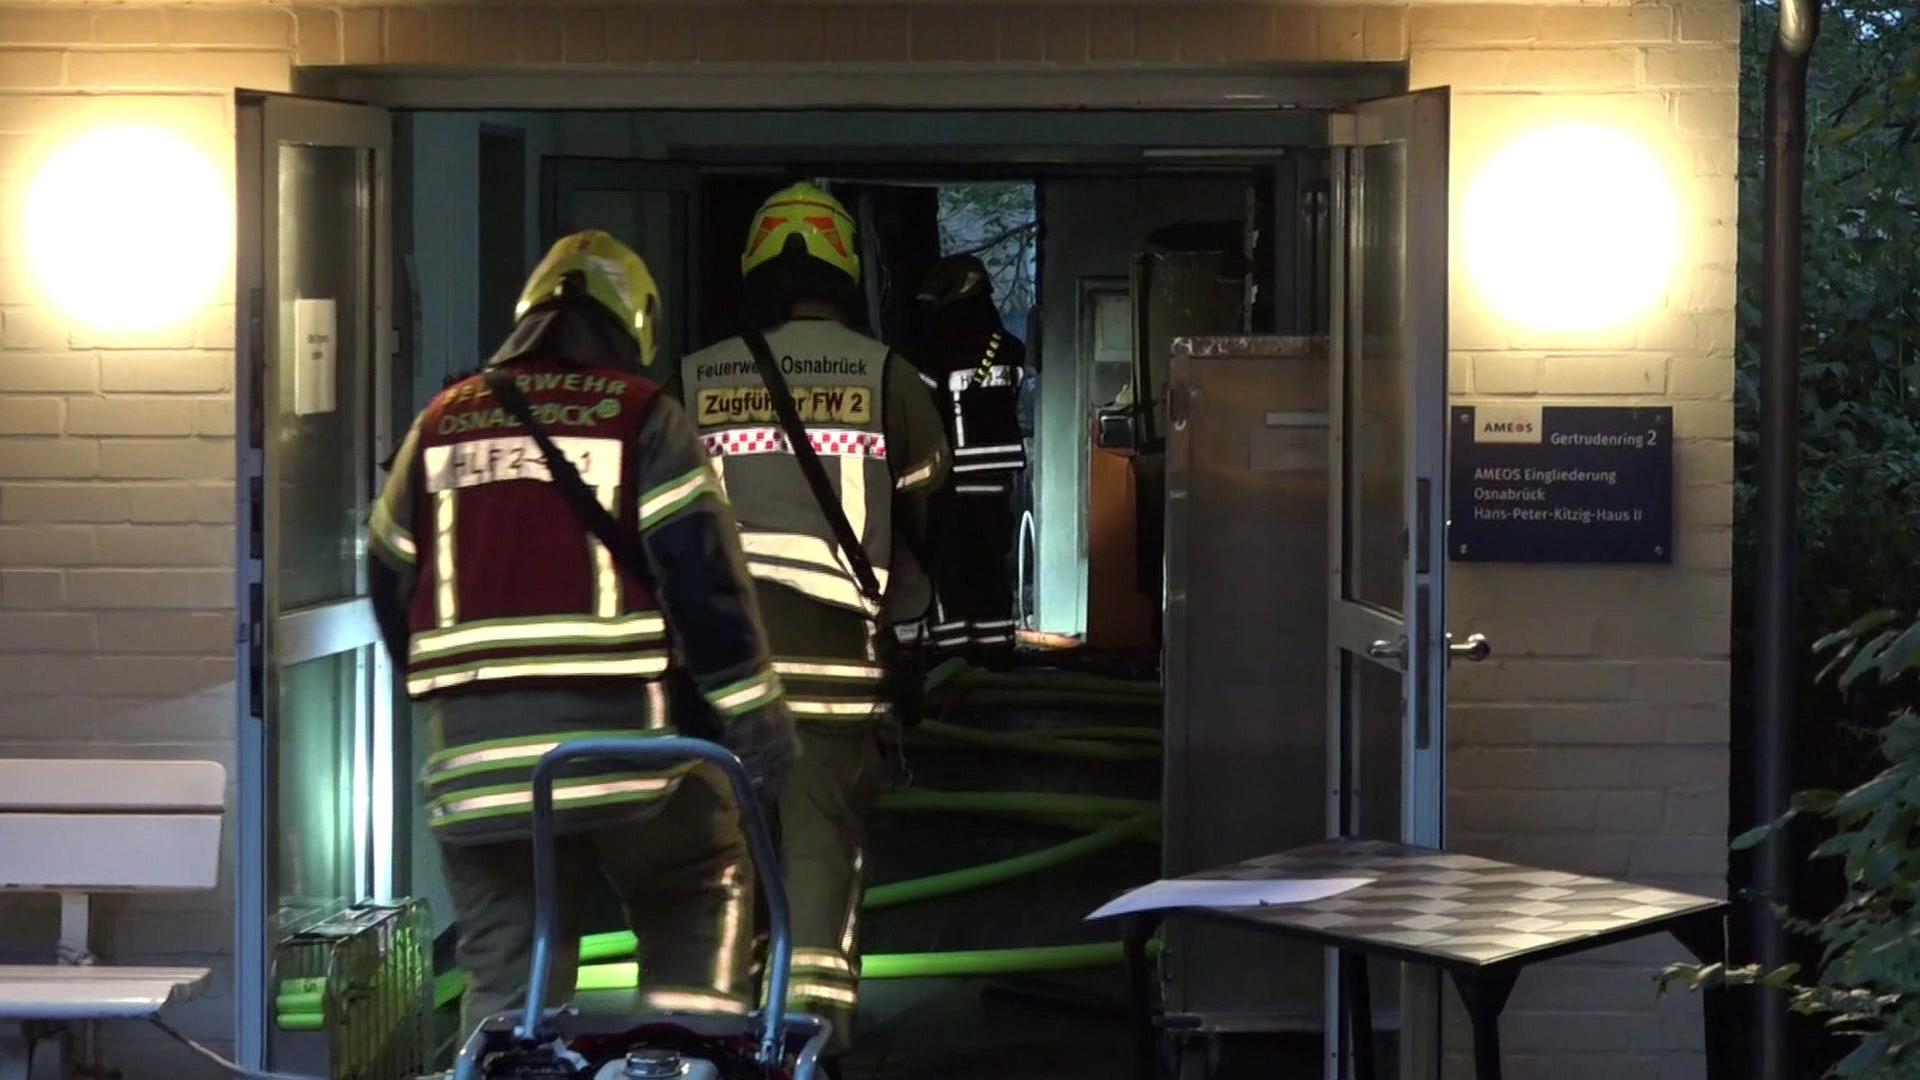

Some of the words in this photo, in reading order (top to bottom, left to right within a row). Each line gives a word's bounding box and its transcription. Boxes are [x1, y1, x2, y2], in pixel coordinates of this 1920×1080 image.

[696, 358, 761, 382] Feuerwe
[780, 355, 868, 376] Osnabrück
[704, 392, 806, 416] Zugführ
[811, 391, 844, 412] FW
[850, 392, 864, 412] 2
[1550, 431, 1644, 448] Gertrudenring
[1646, 429, 1657, 446] 2
[1474, 468, 1521, 481] AMEOS
[1524, 468, 1617, 485] Eingliederung
[1474, 487, 1546, 500] Osnabrück
[1474, 507, 1630, 523] Hans-Peter-Kitzig-Haus
